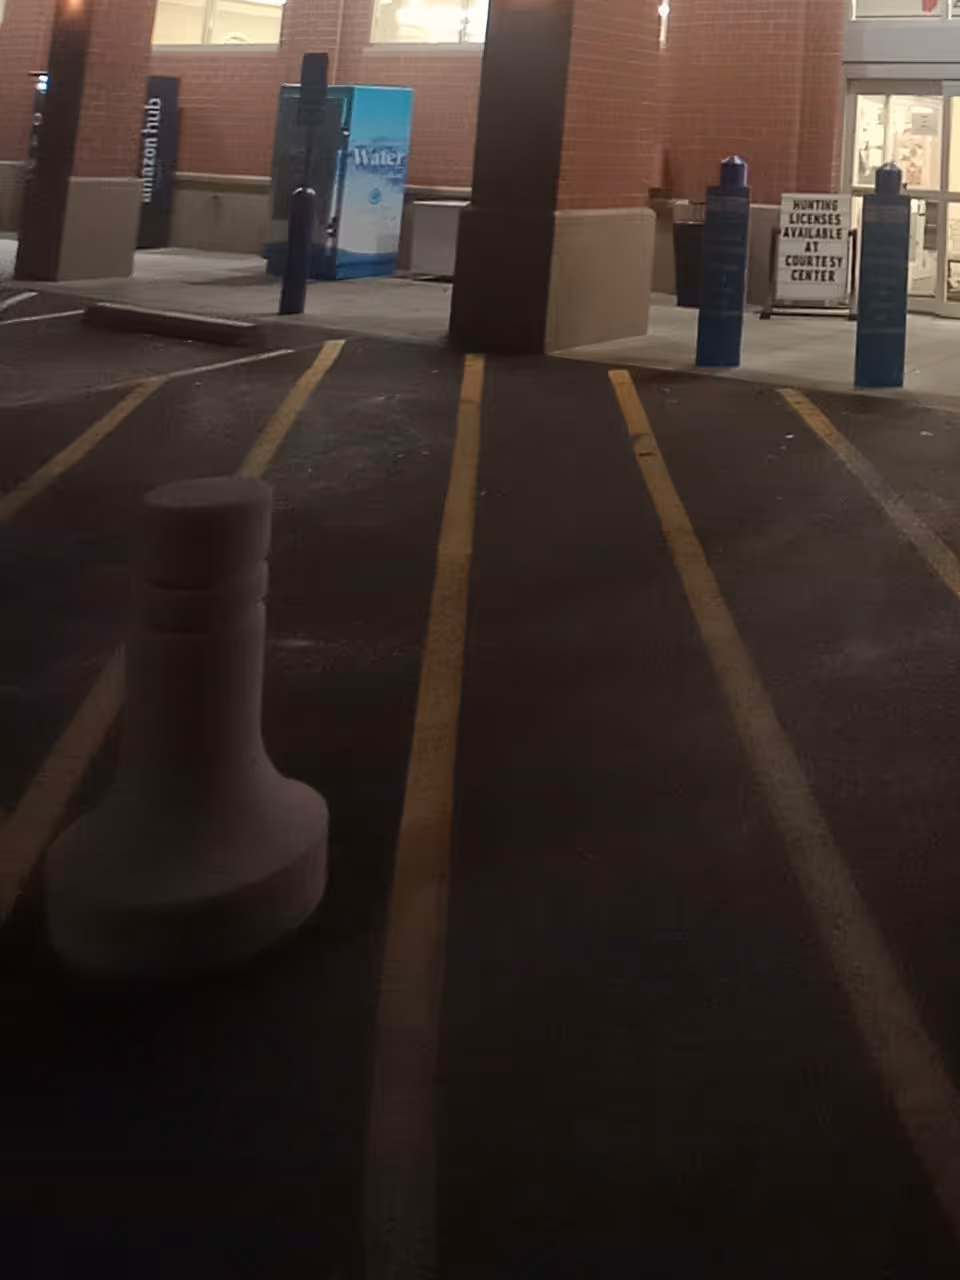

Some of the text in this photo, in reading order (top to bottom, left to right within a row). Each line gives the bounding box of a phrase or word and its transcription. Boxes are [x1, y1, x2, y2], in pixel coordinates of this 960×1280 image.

[140, 98, 161, 134] hub
[353, 147, 405, 166] Water
[792, 200, 838, 211] HUNTING
[788, 213, 841, 225] LICENSES
[782, 227, 842, 239] AVAILABLE
[804, 242, 819, 253] AT
[784, 255, 842, 268] COURTESY
[791, 269, 836, 282] CENTER
